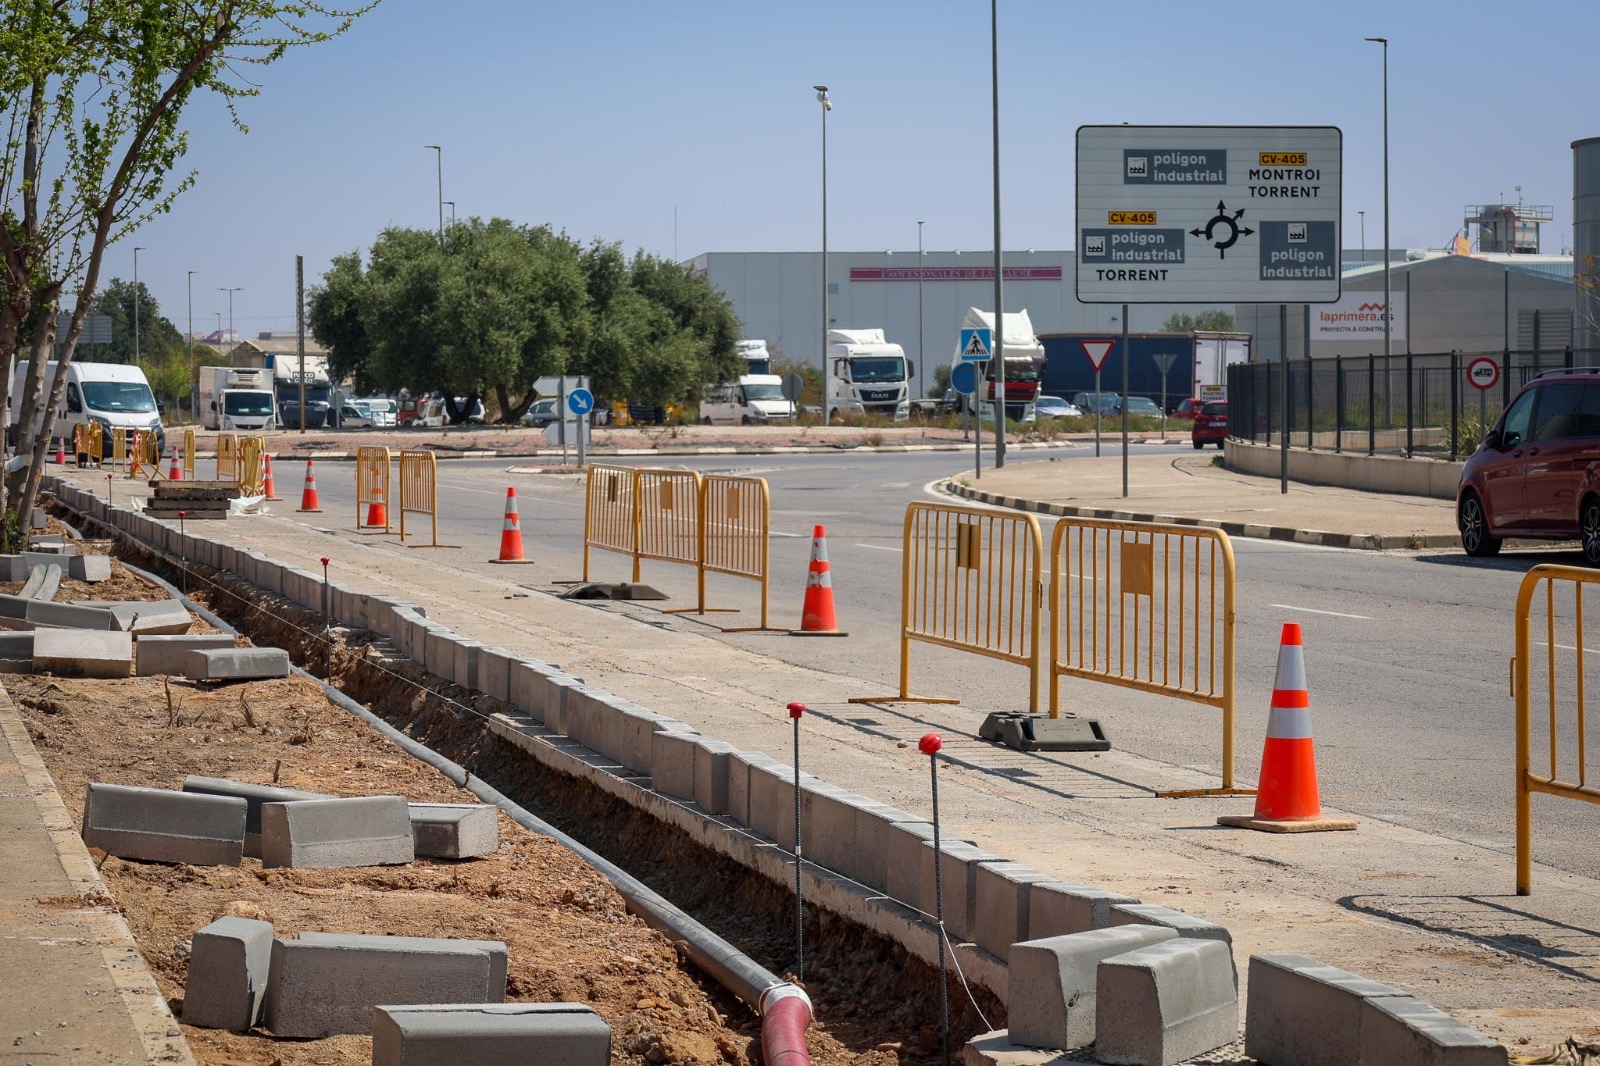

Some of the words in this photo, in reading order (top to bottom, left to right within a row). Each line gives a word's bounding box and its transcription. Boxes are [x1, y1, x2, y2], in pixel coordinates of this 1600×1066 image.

[1153, 152, 1207, 167] polígon
[1261, 154, 1305, 165] CV-405
[1153, 169, 1224, 182] industrial
[1249, 169, 1321, 181] MONTROI
[1248, 186, 1320, 198] TORRENT
[1110, 213, 1155, 223] CV-405
[1111, 231, 1165, 246] polígon
[1111, 249, 1182, 261] industrial
[1271, 248, 1324, 262] polígon
[1096, 269, 1168, 281] TORRENT
[1263, 265, 1332, 278] industrial
[1320, 311, 1394, 324] laprimera.es
